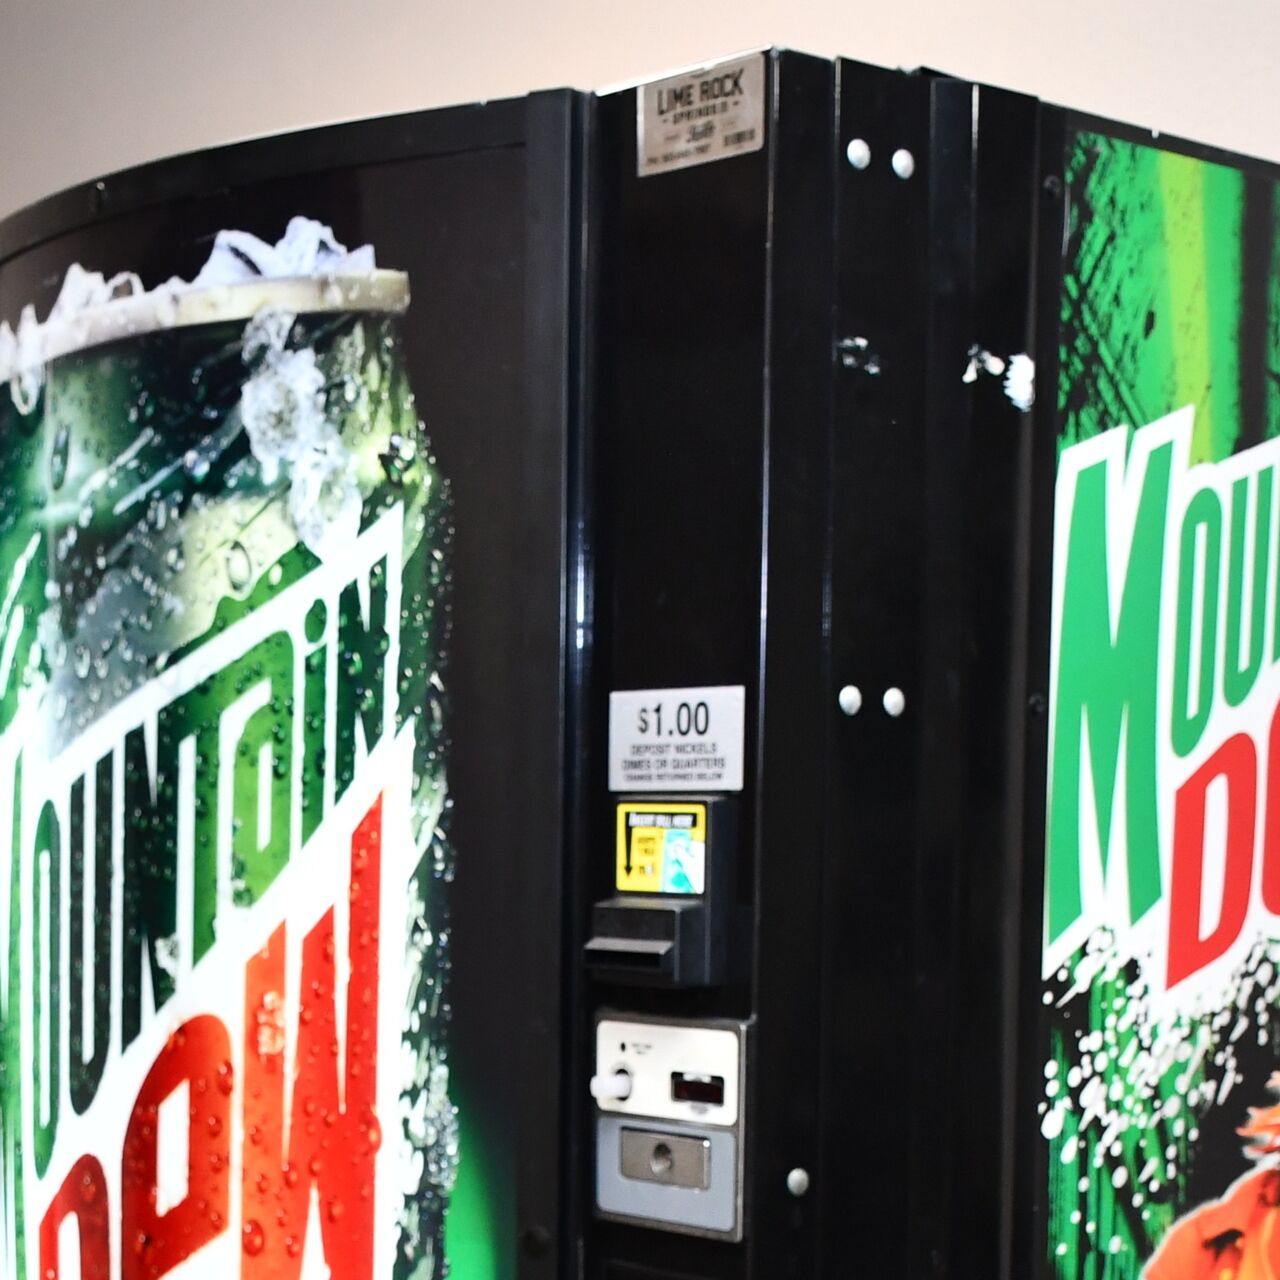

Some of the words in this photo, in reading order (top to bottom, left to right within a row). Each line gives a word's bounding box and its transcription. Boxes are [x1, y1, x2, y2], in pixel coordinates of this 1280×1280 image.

[657, 83, 695, 117] LIME
[699, 68, 744, 102] ROCK
[638, 701, 709, 737] $1.00
